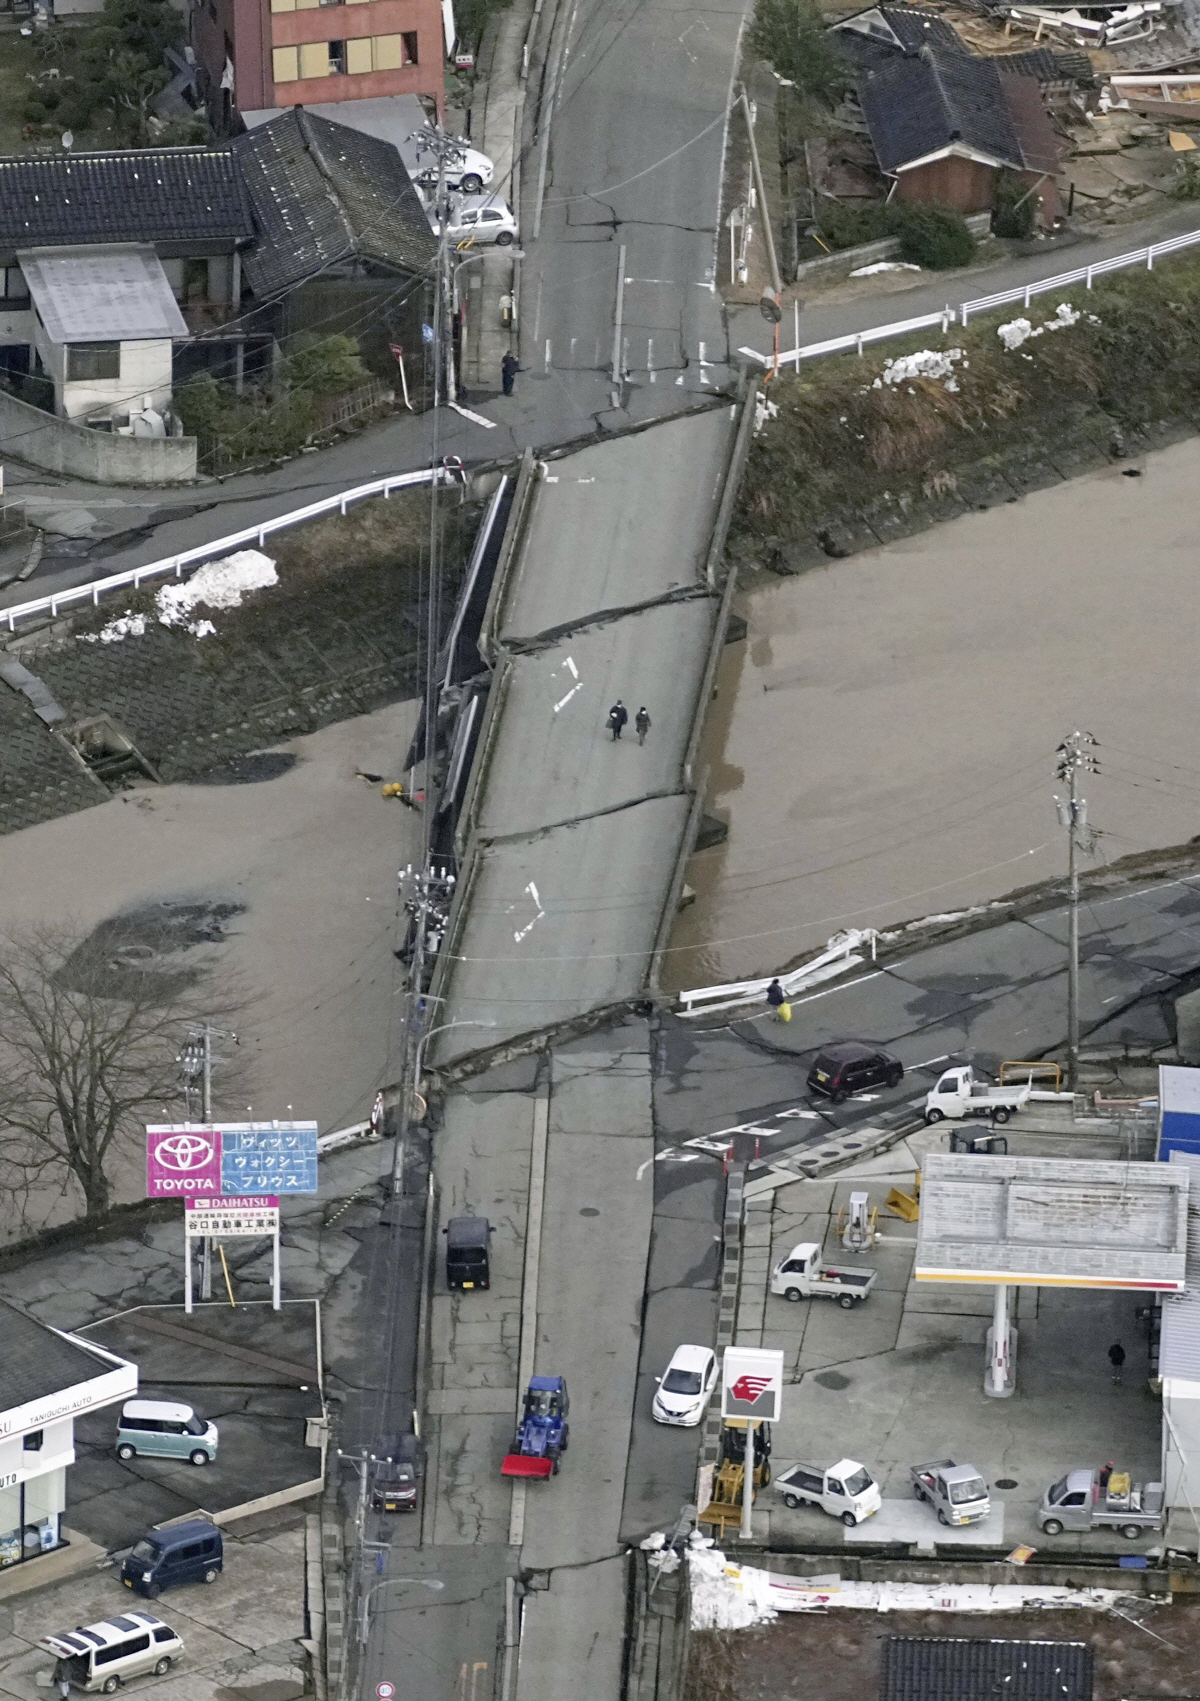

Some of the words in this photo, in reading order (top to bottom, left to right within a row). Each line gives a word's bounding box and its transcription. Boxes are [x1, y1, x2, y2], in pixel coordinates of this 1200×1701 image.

[153, 1178, 214, 1190] TOYOTA
[212, 1197, 269, 1208] DAIHATSU
[30, 1406, 70, 1424] TANIGUCHI
[72, 1396, 92, 1409] AUTO
